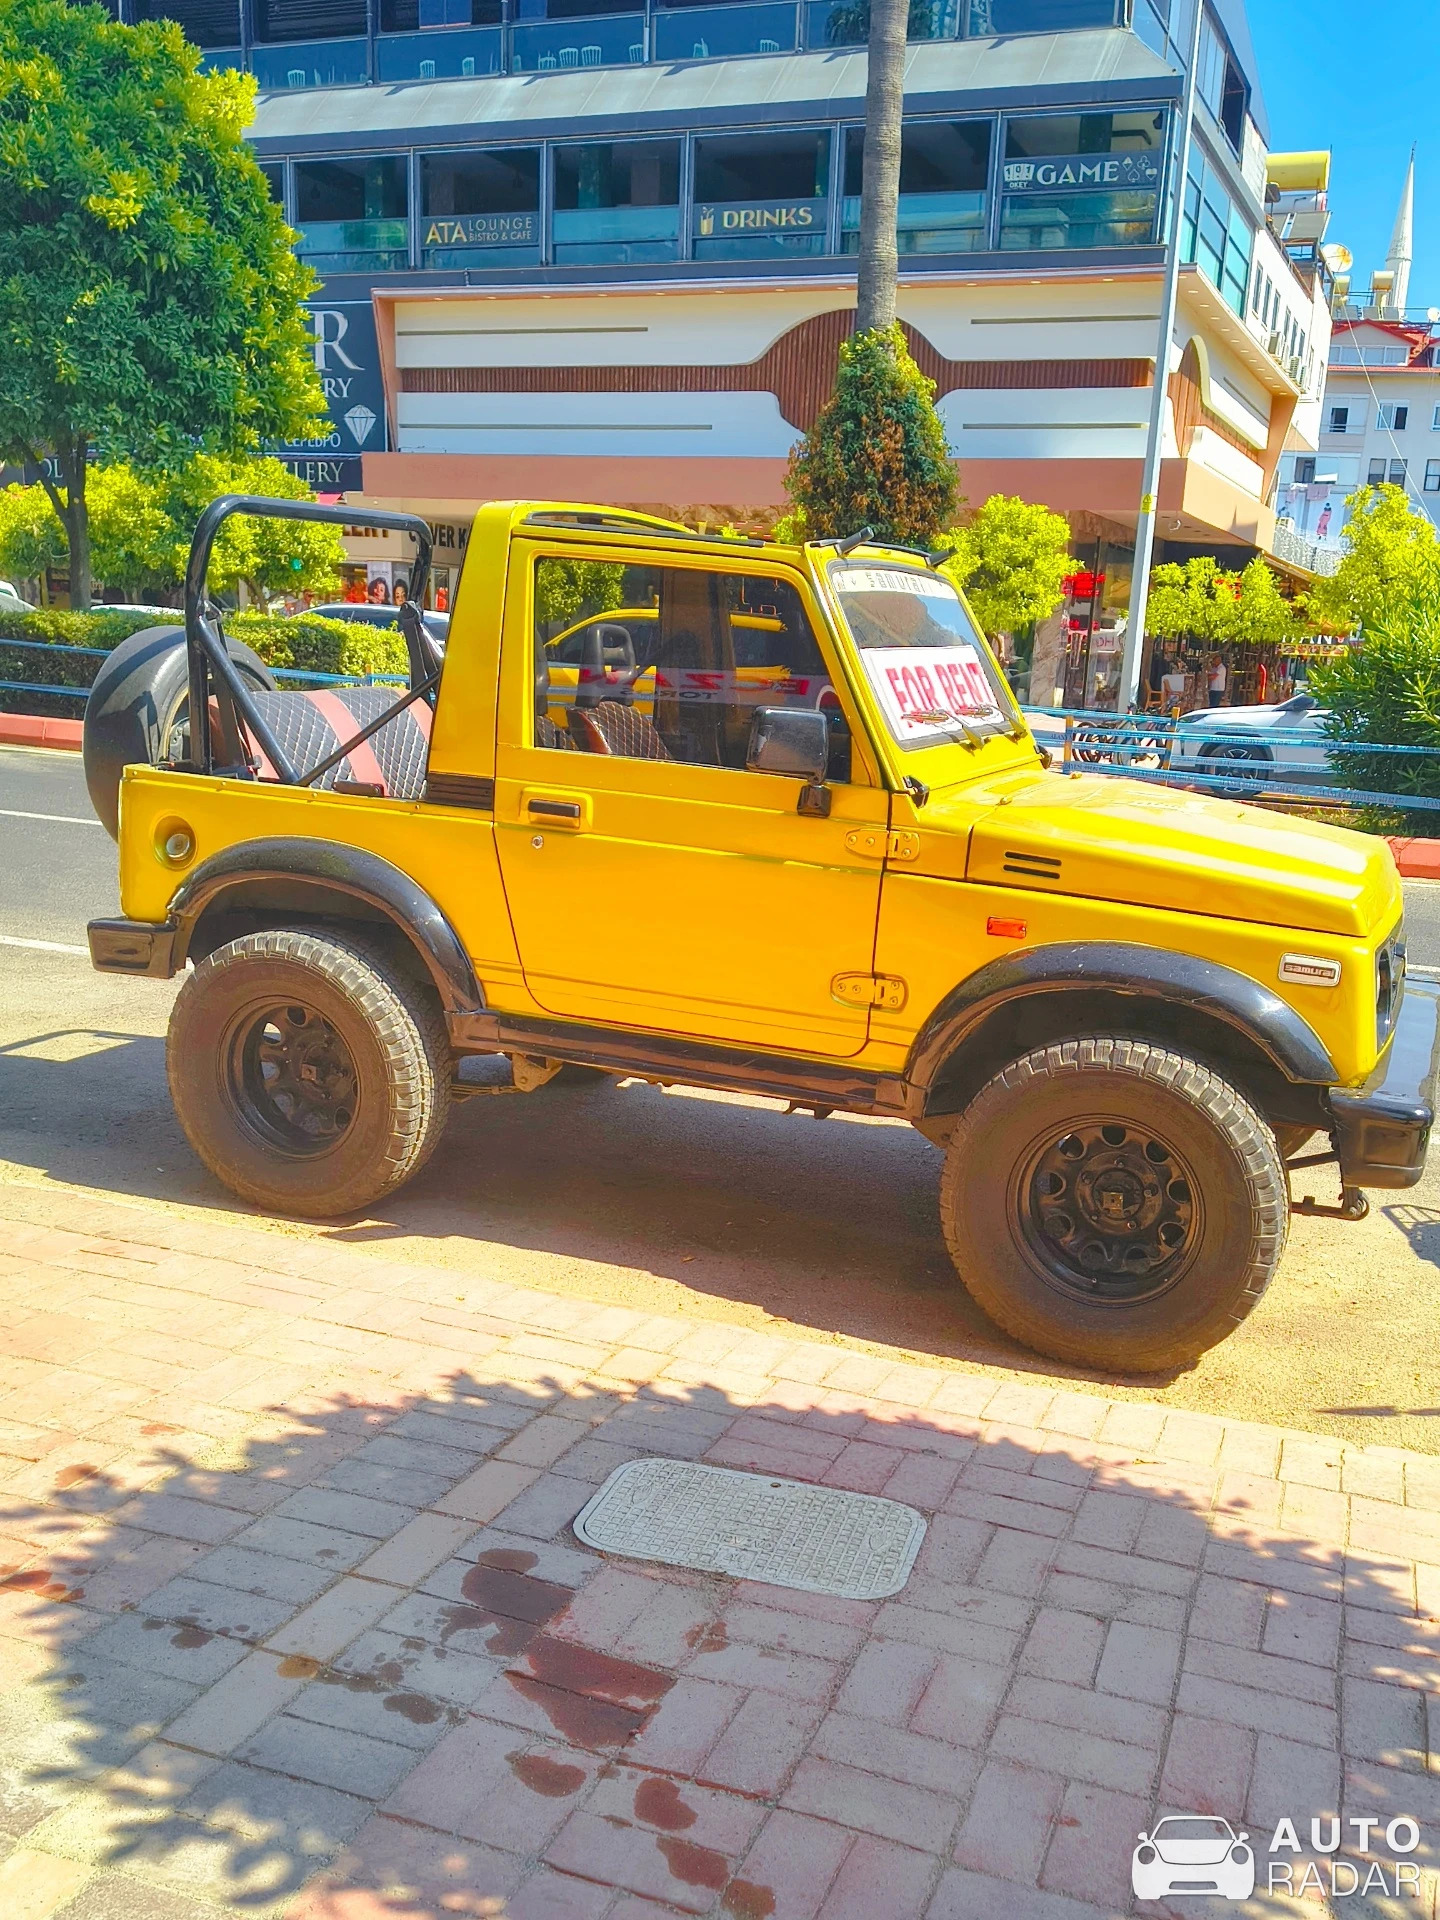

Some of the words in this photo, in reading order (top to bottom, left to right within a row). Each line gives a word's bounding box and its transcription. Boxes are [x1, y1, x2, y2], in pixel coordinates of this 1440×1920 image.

[1036, 161, 1119, 185] GAME
[469, 217, 532, 231] LOUNGE
[723, 207, 813, 228] DRINKS
[426, 222, 467, 244] ATA
[469, 232, 499, 242] BISTRO
[501, 232, 508, 241] &
[311, 311, 365, 371] R
[324, 377, 353, 398] RY
[291, 461, 344, 482] LERY
[885, 666, 941, 718] FOR
[933, 663, 992, 714] RENT
